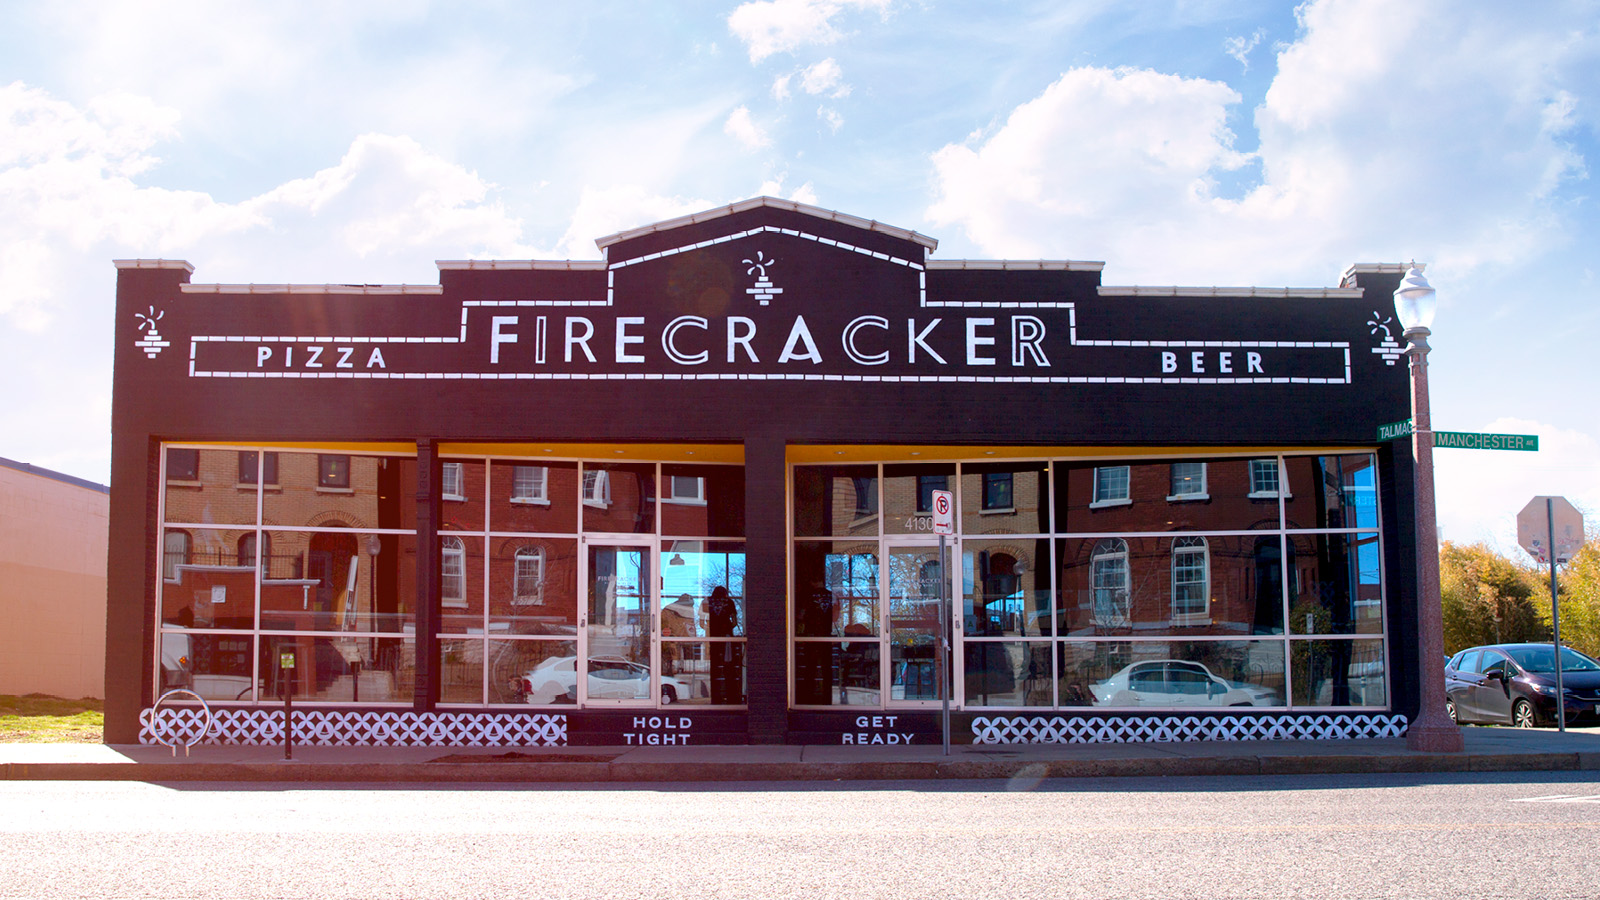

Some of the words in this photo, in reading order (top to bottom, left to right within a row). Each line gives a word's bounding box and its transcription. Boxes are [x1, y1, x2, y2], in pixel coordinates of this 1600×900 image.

[490, 314, 1051, 368] FIRECRACKER
[257, 346, 386, 369] PIZZA
[1161, 350, 1265, 374] BEER
[1438, 433, 1524, 449] MANCHESTER
[905, 517, 933, 531] 4130
[633, 716, 692, 729] HOLD
[855, 715, 898, 728] GET
[623, 732, 692, 746] TIGHT
[842, 732, 915, 746] READY
